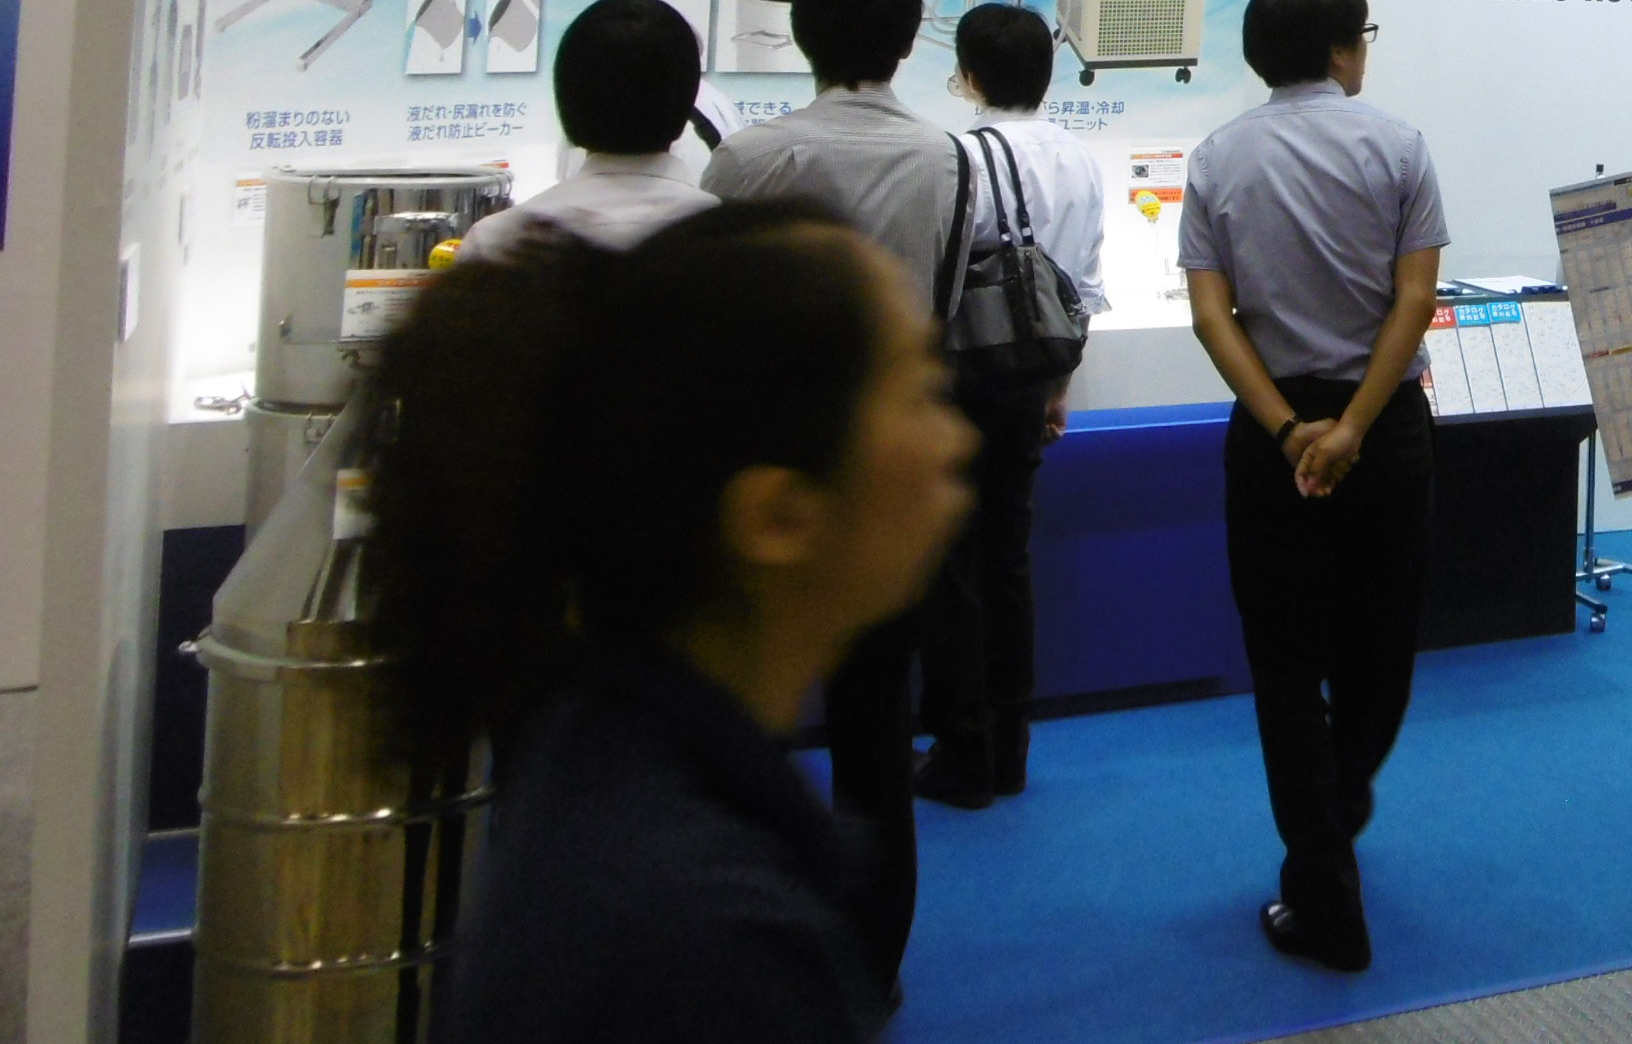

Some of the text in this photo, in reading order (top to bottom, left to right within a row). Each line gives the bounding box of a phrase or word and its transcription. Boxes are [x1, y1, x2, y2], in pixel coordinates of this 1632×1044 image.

[249, 129, 344, 150] 反転投入容器
[407, 121, 524, 141] 液だれ防止ビーカー
